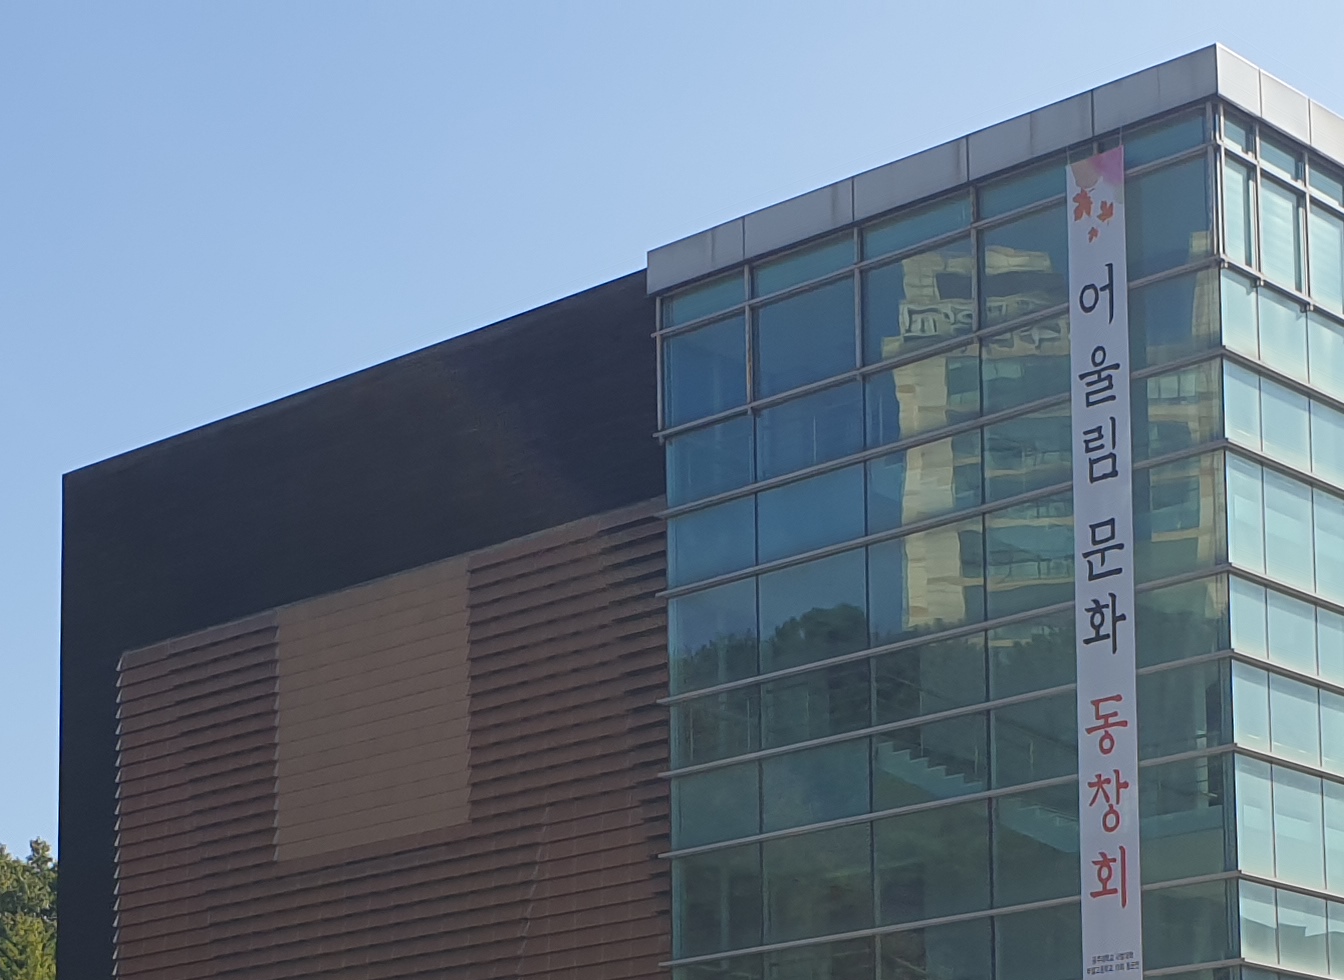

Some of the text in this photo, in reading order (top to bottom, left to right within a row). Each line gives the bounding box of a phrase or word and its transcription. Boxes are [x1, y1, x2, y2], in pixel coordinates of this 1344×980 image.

[1078, 263, 1120, 484] 어울림
[1081, 517, 1126, 655] 문화
[1084, 694, 1129, 909] 동창회
